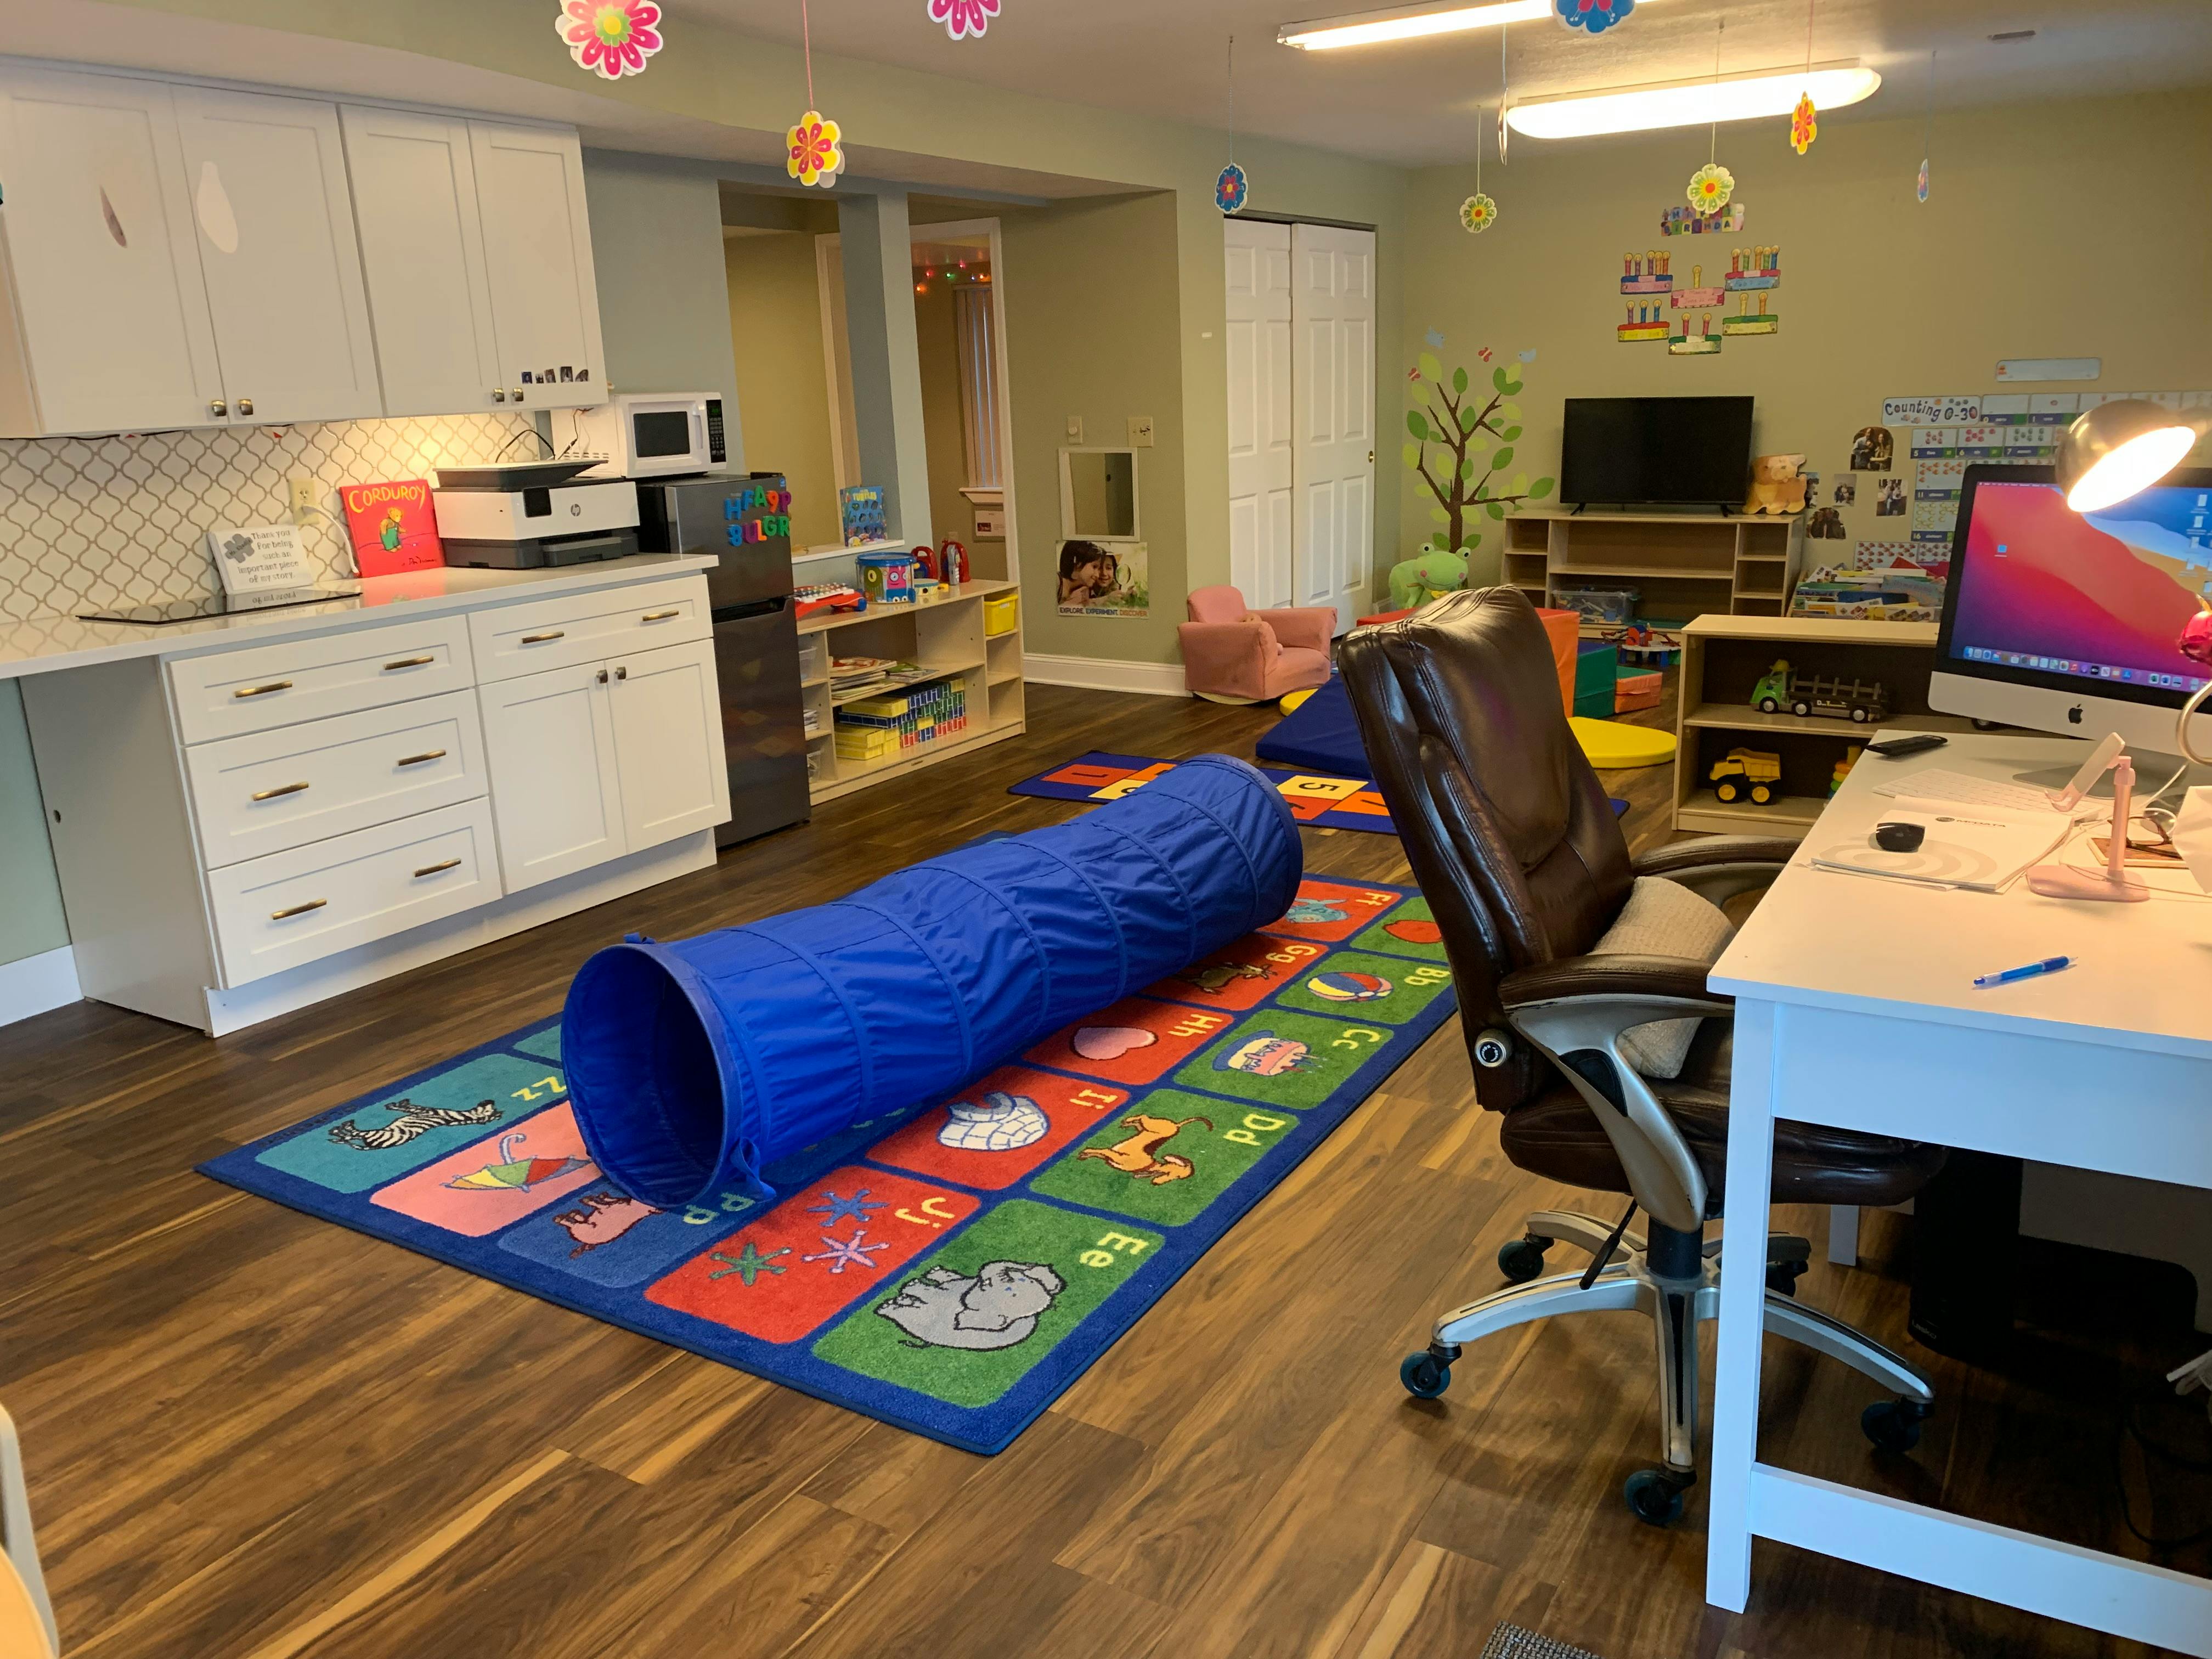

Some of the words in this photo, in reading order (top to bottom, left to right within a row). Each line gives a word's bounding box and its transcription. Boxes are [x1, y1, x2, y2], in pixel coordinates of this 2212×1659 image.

[1884, 400, 1942, 422] Counting
[1944, 405, 1978, 421] 0-30
[348, 485, 426, 514] CORDUROY
[251, 531, 274, 540] Thank
[275, 529, 291, 538] you
[257, 541, 270, 550] for
[272, 539, 294, 549] being
[262, 552, 280, 560] such
[279, 560, 300, 570] piece
[249, 575, 258, 584] of
[1298, 782, 1340, 792] 5
[1355, 891, 1392, 906] Ff
[1265, 945, 1317, 963] Gg
[1404, 967, 1451, 986] Bb
[1167, 1013, 1223, 1037] Hh
[1331, 1029, 1381, 1050] Cc
[510, 1075, 567, 1102] Zz
[1069, 1088, 1119, 1110] Ii
[1223, 1113, 1287, 1147] Dd
[682, 1191, 756, 1226] Pp
[894, 1196, 955, 1229] Jj
[1079, 1231, 1150, 1268] Ee
